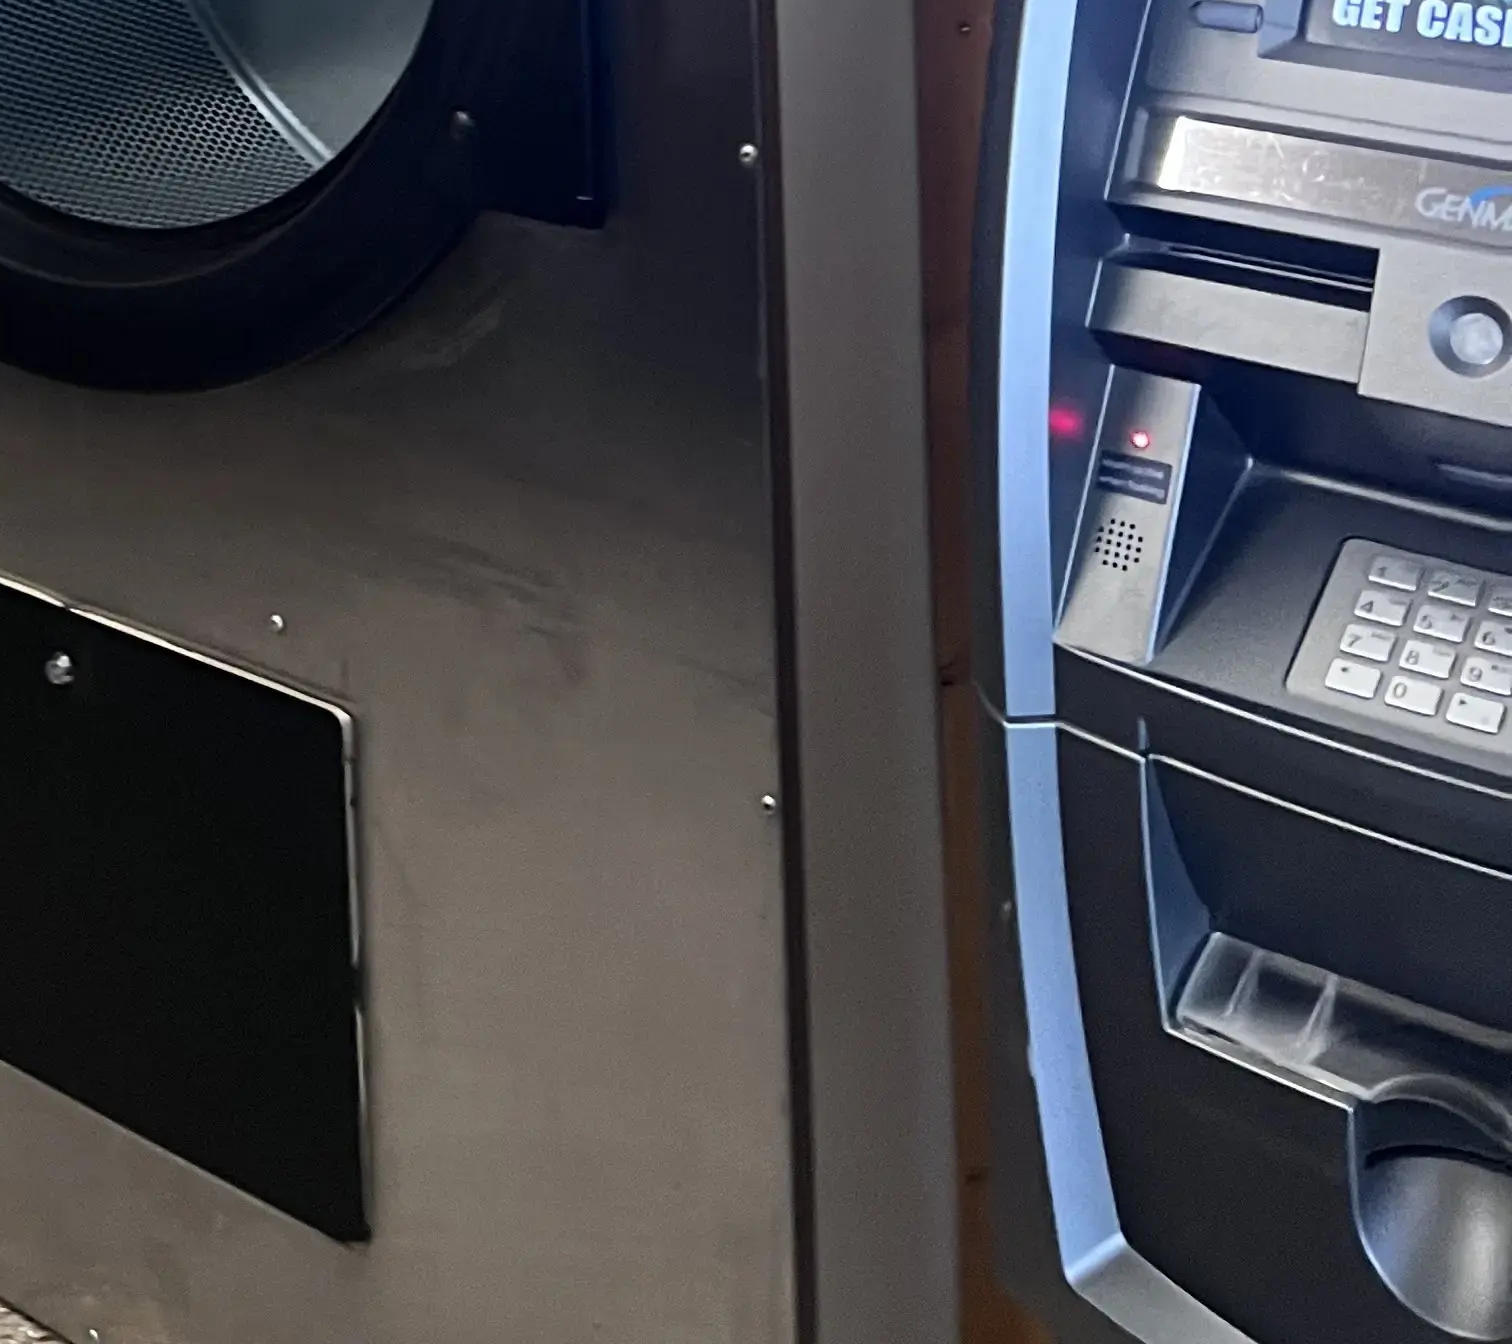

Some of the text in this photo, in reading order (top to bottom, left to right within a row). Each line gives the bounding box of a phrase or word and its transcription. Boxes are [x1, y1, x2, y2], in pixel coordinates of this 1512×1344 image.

[1360, 600, 1374, 613] 4
[1347, 634, 1363, 647] 7
[1406, 650, 1420, 665] 8
[1393, 682, 1408, 699] 0
